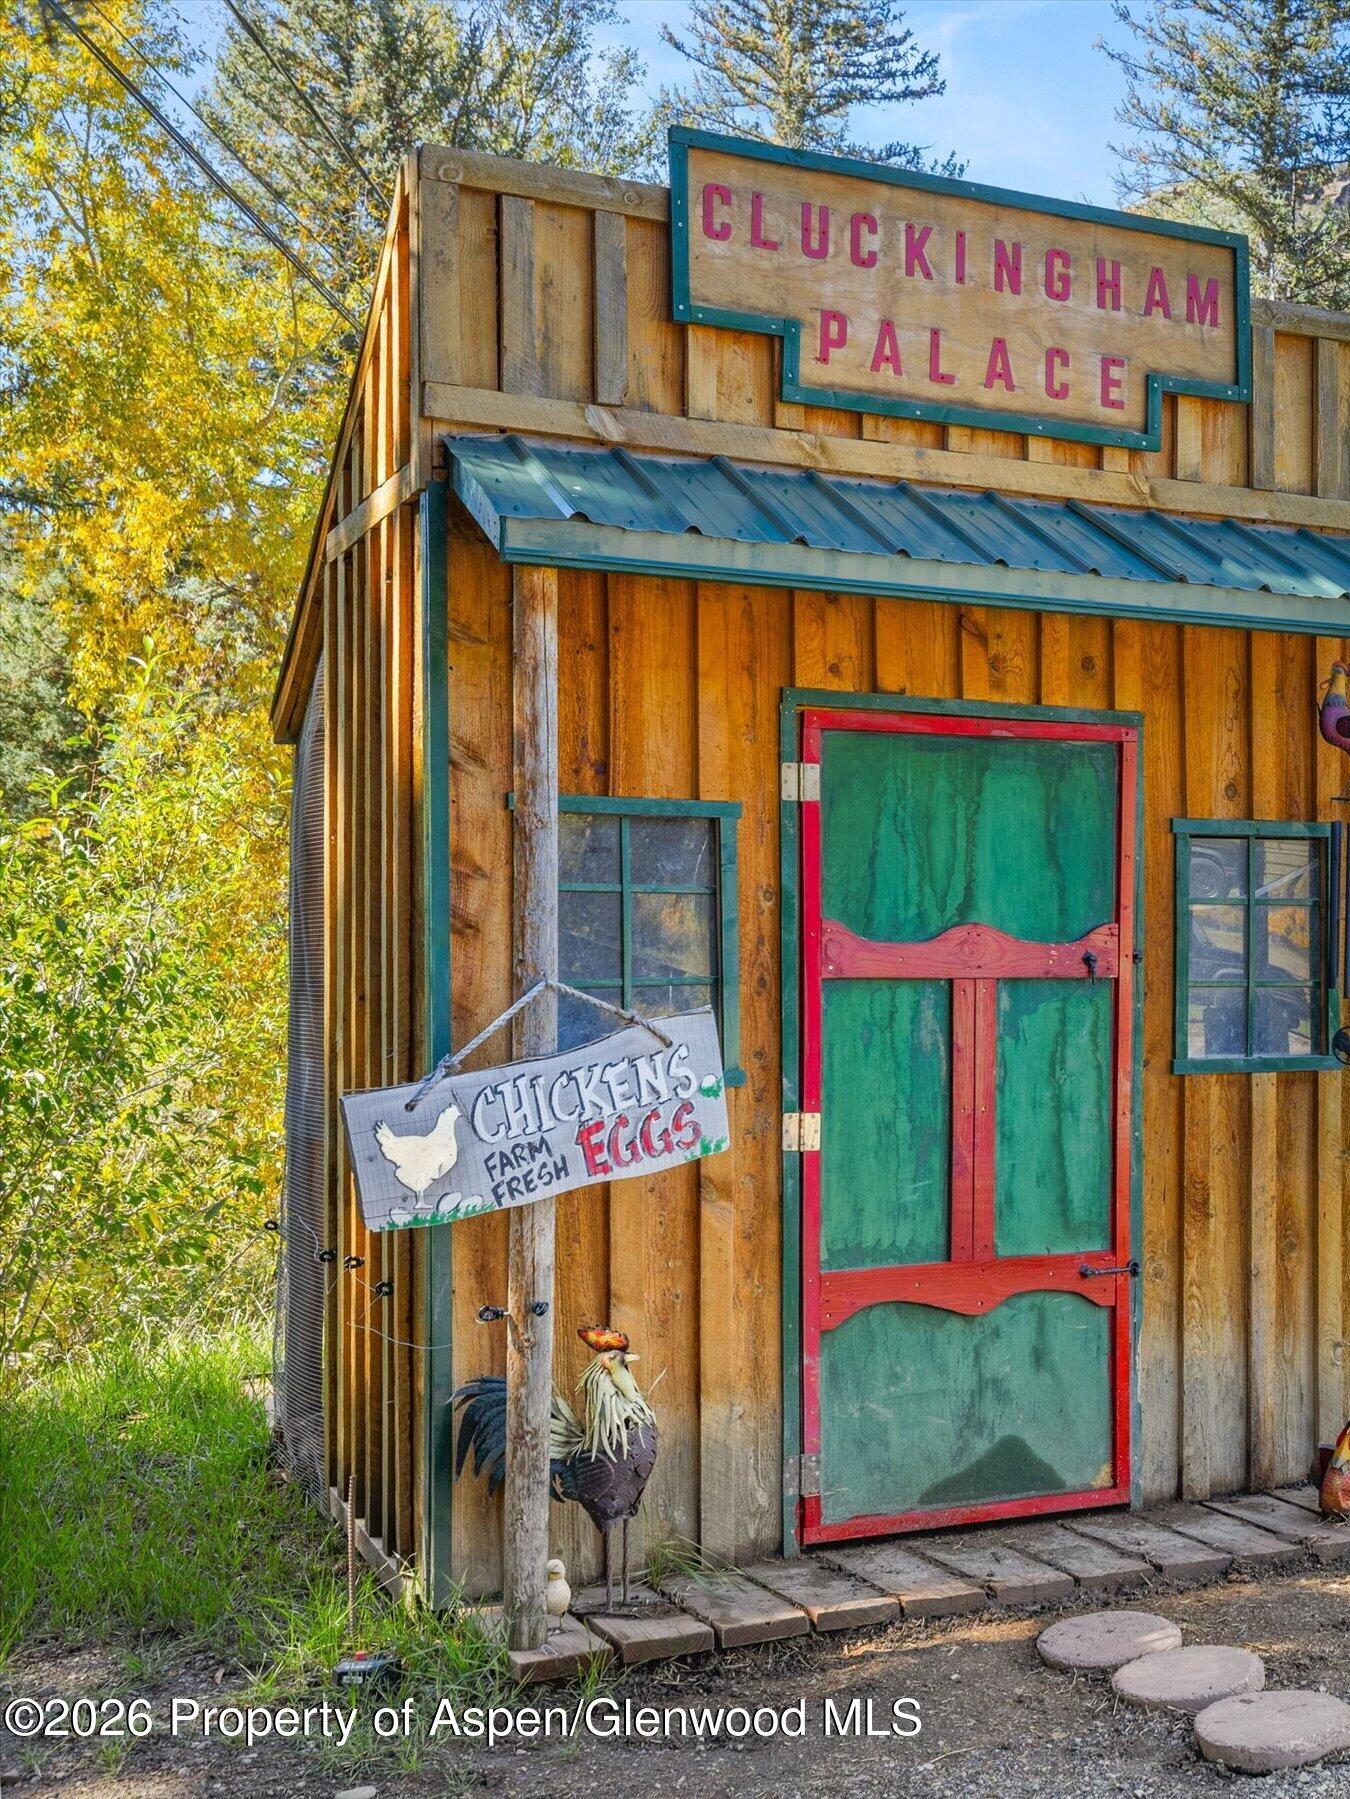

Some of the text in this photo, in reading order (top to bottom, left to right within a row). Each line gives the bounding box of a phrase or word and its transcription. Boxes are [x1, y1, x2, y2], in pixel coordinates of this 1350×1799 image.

[702, 183, 1220, 328] CLUCKINGHAM
[817, 309, 1125, 410] PALACE
[470, 1043, 699, 1145] CHICKENS
[484, 1135, 554, 1182] FARM
[491, 1155, 569, 1208] FRESH
[576, 1101, 703, 1179] EGGS
